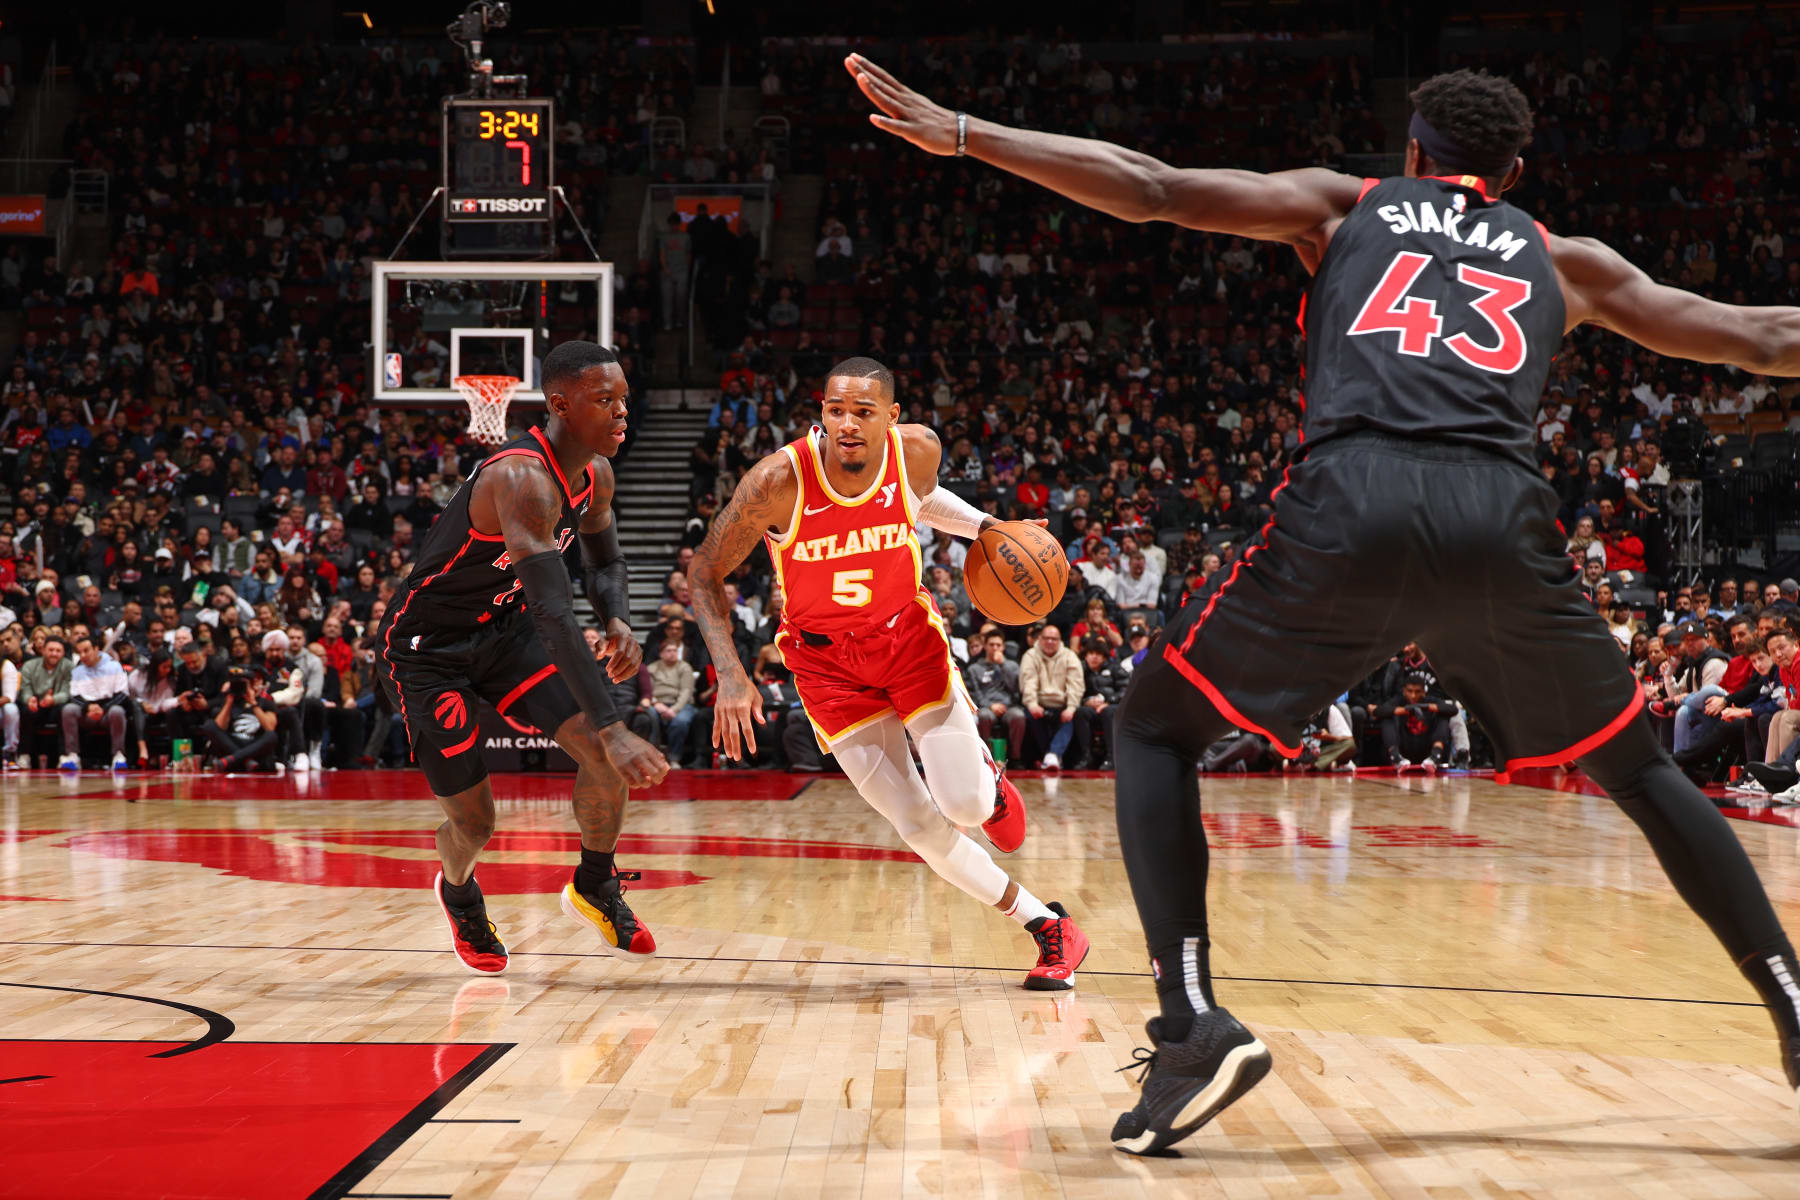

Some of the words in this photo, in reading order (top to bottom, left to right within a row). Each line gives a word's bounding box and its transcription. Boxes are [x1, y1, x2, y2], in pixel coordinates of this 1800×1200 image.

[479, 110, 539, 139] 3:24
[505, 140, 531, 186] 7
[477, 199, 546, 213] TISSOT
[1377, 200, 1528, 262] SIAKAM
[1346, 250, 1532, 375] 43
[792, 523, 908, 562] ATLANTA
[832, 568, 874, 607] 5
[997, 541, 1045, 607] Wilson
[485, 737, 512, 749] AIR
